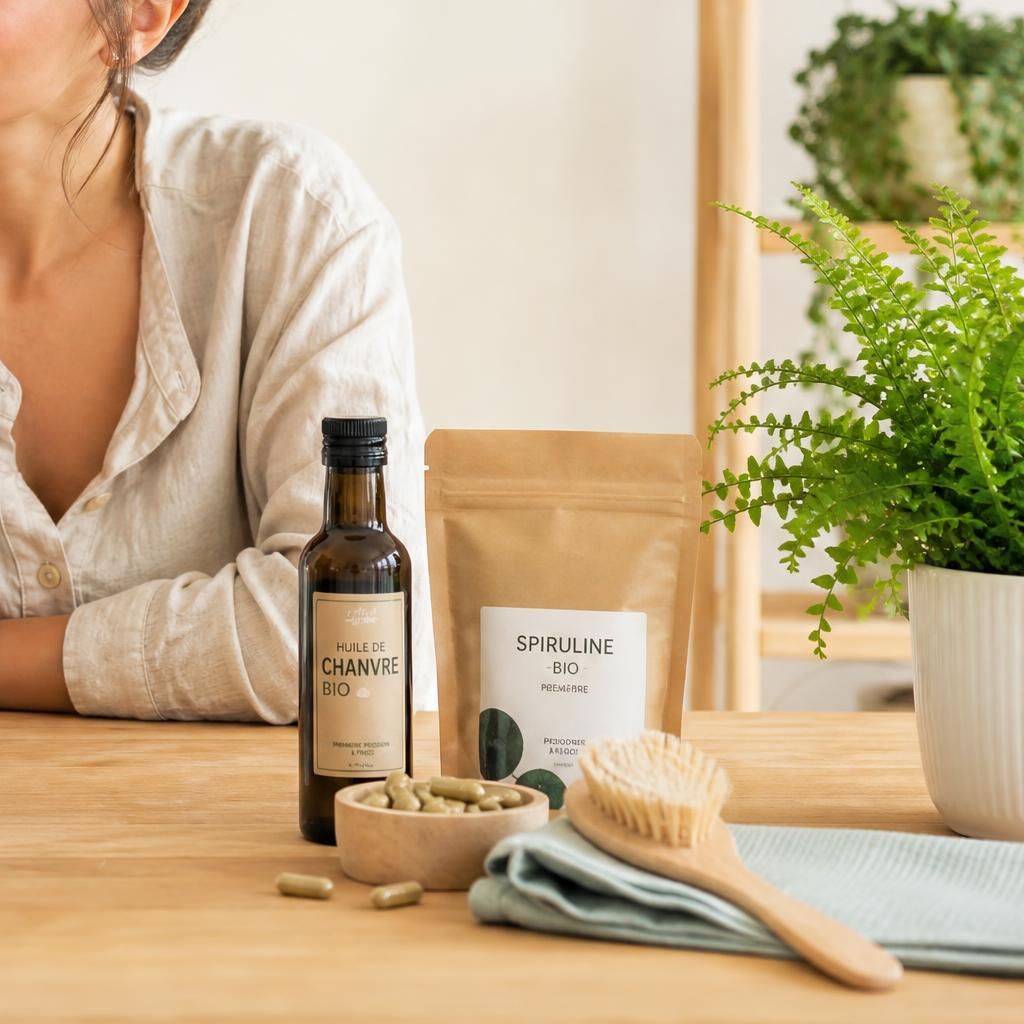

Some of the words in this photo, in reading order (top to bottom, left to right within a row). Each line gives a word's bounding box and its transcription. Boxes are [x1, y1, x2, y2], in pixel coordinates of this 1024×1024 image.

[336, 641, 369, 653] HUILE
[372, 641, 386, 653] DE
[516, 635, 615, 655] SPIRULINE
[321, 656, 399, 676] CHANVRE
[322, 681, 351, 697] BIO
